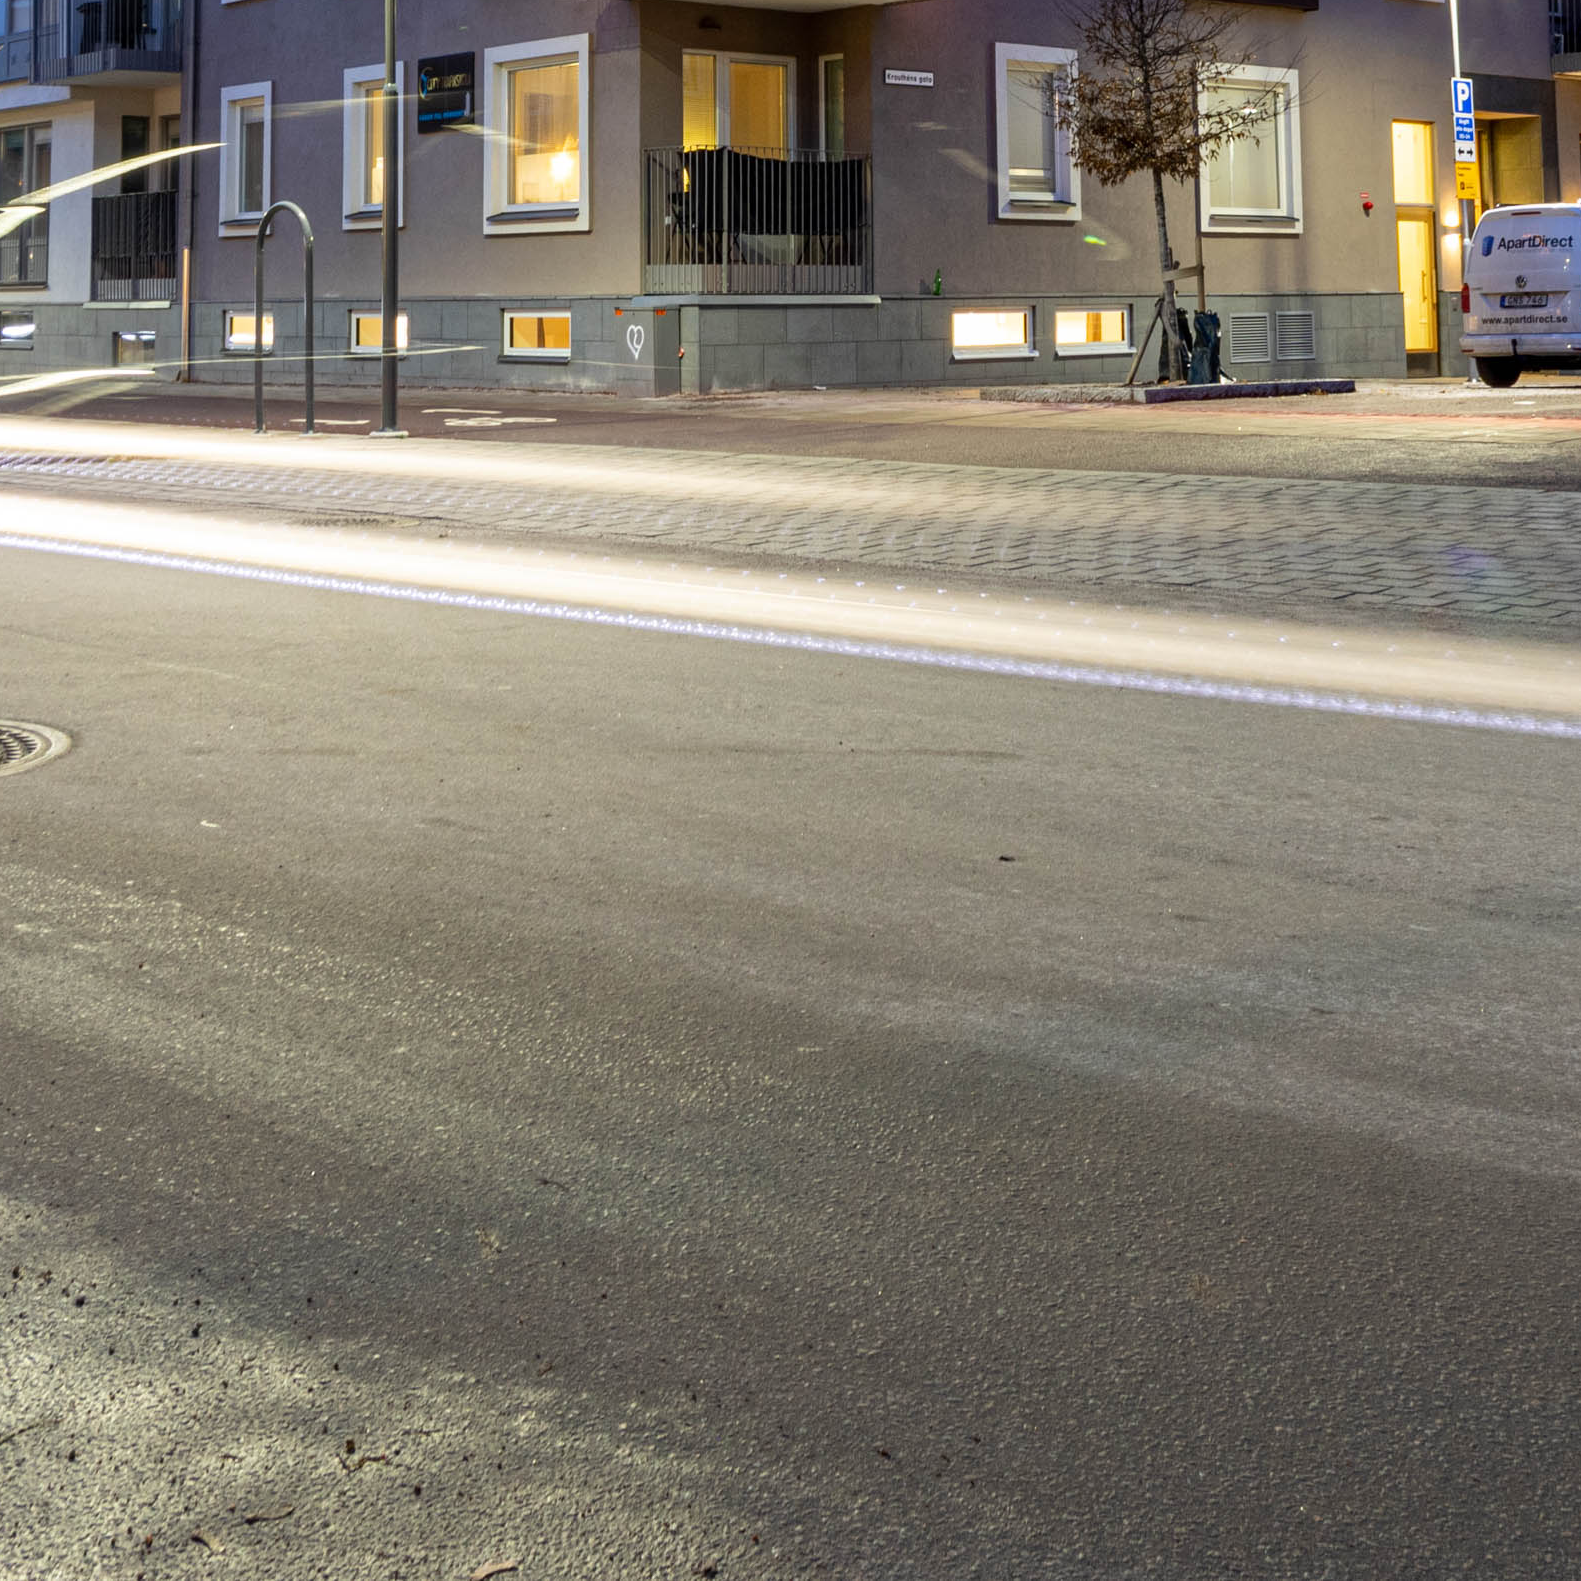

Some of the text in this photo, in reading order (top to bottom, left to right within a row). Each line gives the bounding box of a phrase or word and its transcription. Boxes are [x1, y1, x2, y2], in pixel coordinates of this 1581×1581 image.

[1457, 82, 1470, 111] P
[1498, 235, 1574, 251] ApartDirect
[1482, 315, 1568, 326] www.apartdirect.se
